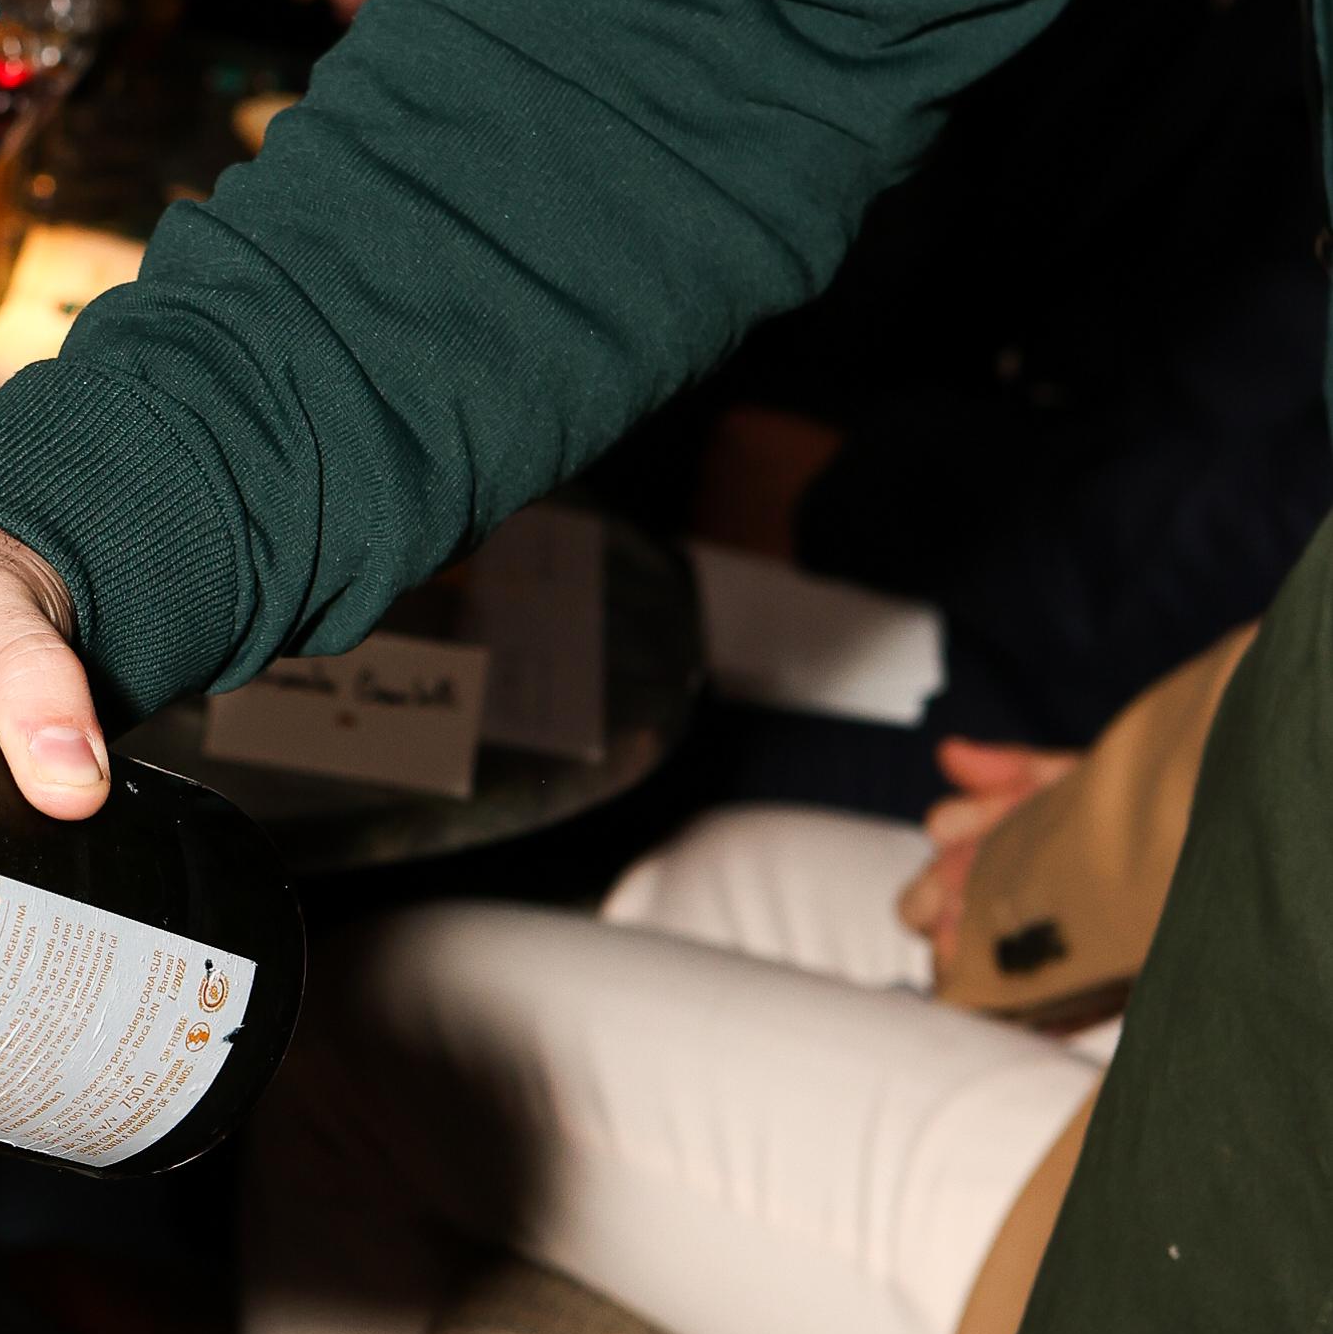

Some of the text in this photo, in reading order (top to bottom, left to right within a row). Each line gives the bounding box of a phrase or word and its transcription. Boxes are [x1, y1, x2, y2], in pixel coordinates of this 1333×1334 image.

[1, 904, 27, 966] ARGENTINA
[79, 927, 97, 963] Hilario,
[5, 925, 37, 990] CALINGASTA
[15, 999, 30, 1016] 0,3
[35, 937, 56, 981] plantada
[51, 915, 62, 935] con
[47, 967, 59, 981] de
[49, 976, 67, 1001] 1500
[73, 922, 84, 940] Los
[52, 949, 65, 964] 50
[73, 945, 103, 1009] fermentación
[98, 930, 107, 943] es
[74, 964, 85, 978] de
[37, 984, 52, 1004] más
[64, 978, 80, 1000] baja
[68, 1016, 88, 1042] vasija
[84, 1001, 96, 1015] de
[90, 950, 114, 1001] hormigón
[107, 933, 118, 949] (al
[109, 1045, 124, 1064] por
[118, 1006, 145, 1045] Bodega
[138, 975, 157, 1004] CARA
[149, 949, 163, 974] SUR
[131, 1024, 151, 1049] Roca
[144, 1001, 160, 1022] S/N
[156, 953, 175, 994] Barreal
[28, 1006, 41, 1019] de
[48, 999, 70, 1029] fluvial
[29, 1028, 54, 1057] terraza
[117, 1086, 145, 1109] 750
[140, 1070, 158, 1087] ml
[152, 1058, 185, 1096] PROHIBIDA
[88, 1074, 135, 1119] ARGENTNA
[126, 1107, 161, 1135] MENORES
[156, 1097, 170, 1108] DE
